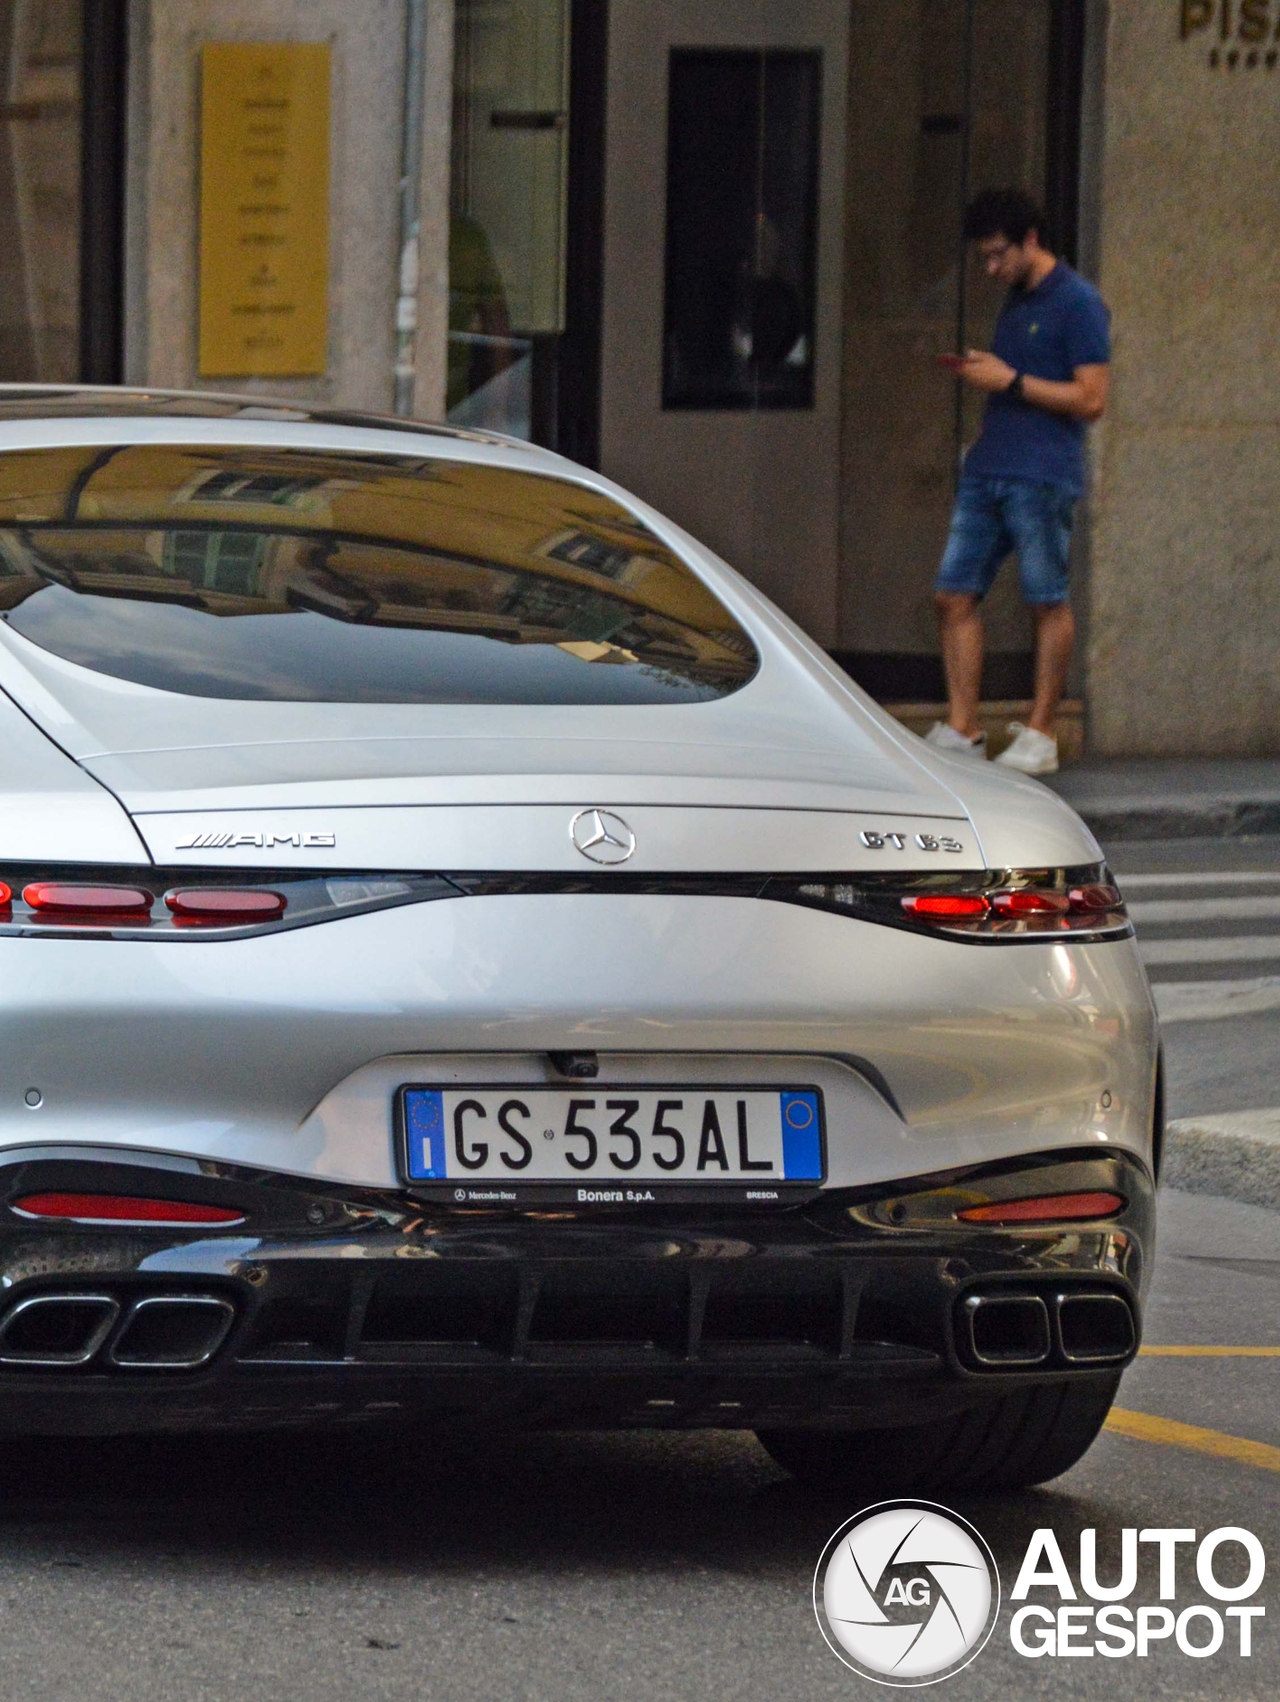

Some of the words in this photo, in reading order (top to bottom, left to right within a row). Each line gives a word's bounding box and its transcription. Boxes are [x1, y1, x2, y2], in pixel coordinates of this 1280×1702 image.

[1178, 0, 1280, 41] PIS
[226, 832, 336, 849] AMG
[858, 831, 906, 850] GT
[914, 834, 963, 852] 63
[453, 1099, 533, 1170] GS
[564, 1099, 773, 1171] 535AL
[468, 1190, 517, 1200] Mercedes-Benz
[577, 1189, 624, 1202] Bonera
[626, 1190, 656, 1202] S.p.A.
[746, 1190, 779, 1200] BRESCIA
